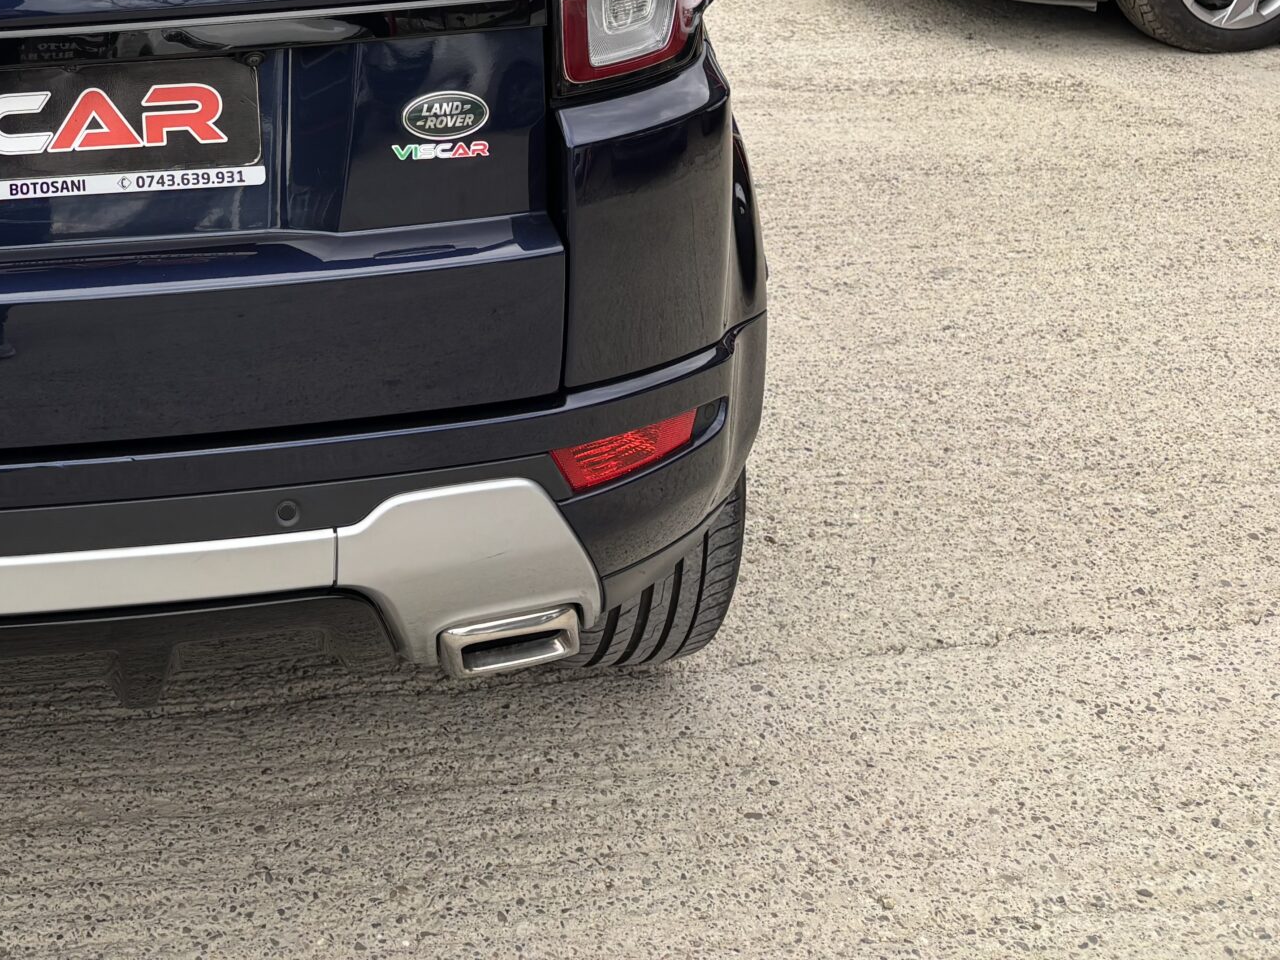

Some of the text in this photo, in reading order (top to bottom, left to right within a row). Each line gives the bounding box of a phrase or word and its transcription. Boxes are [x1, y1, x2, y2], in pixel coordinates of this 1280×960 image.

[422, 101, 462, 116] LAND
[425, 114, 474, 129] ROVER
[391, 141, 489, 160] VISCAR
[9, 179, 86, 196] BOTOSANI
[135, 170, 246, 189] 0743.639.931
